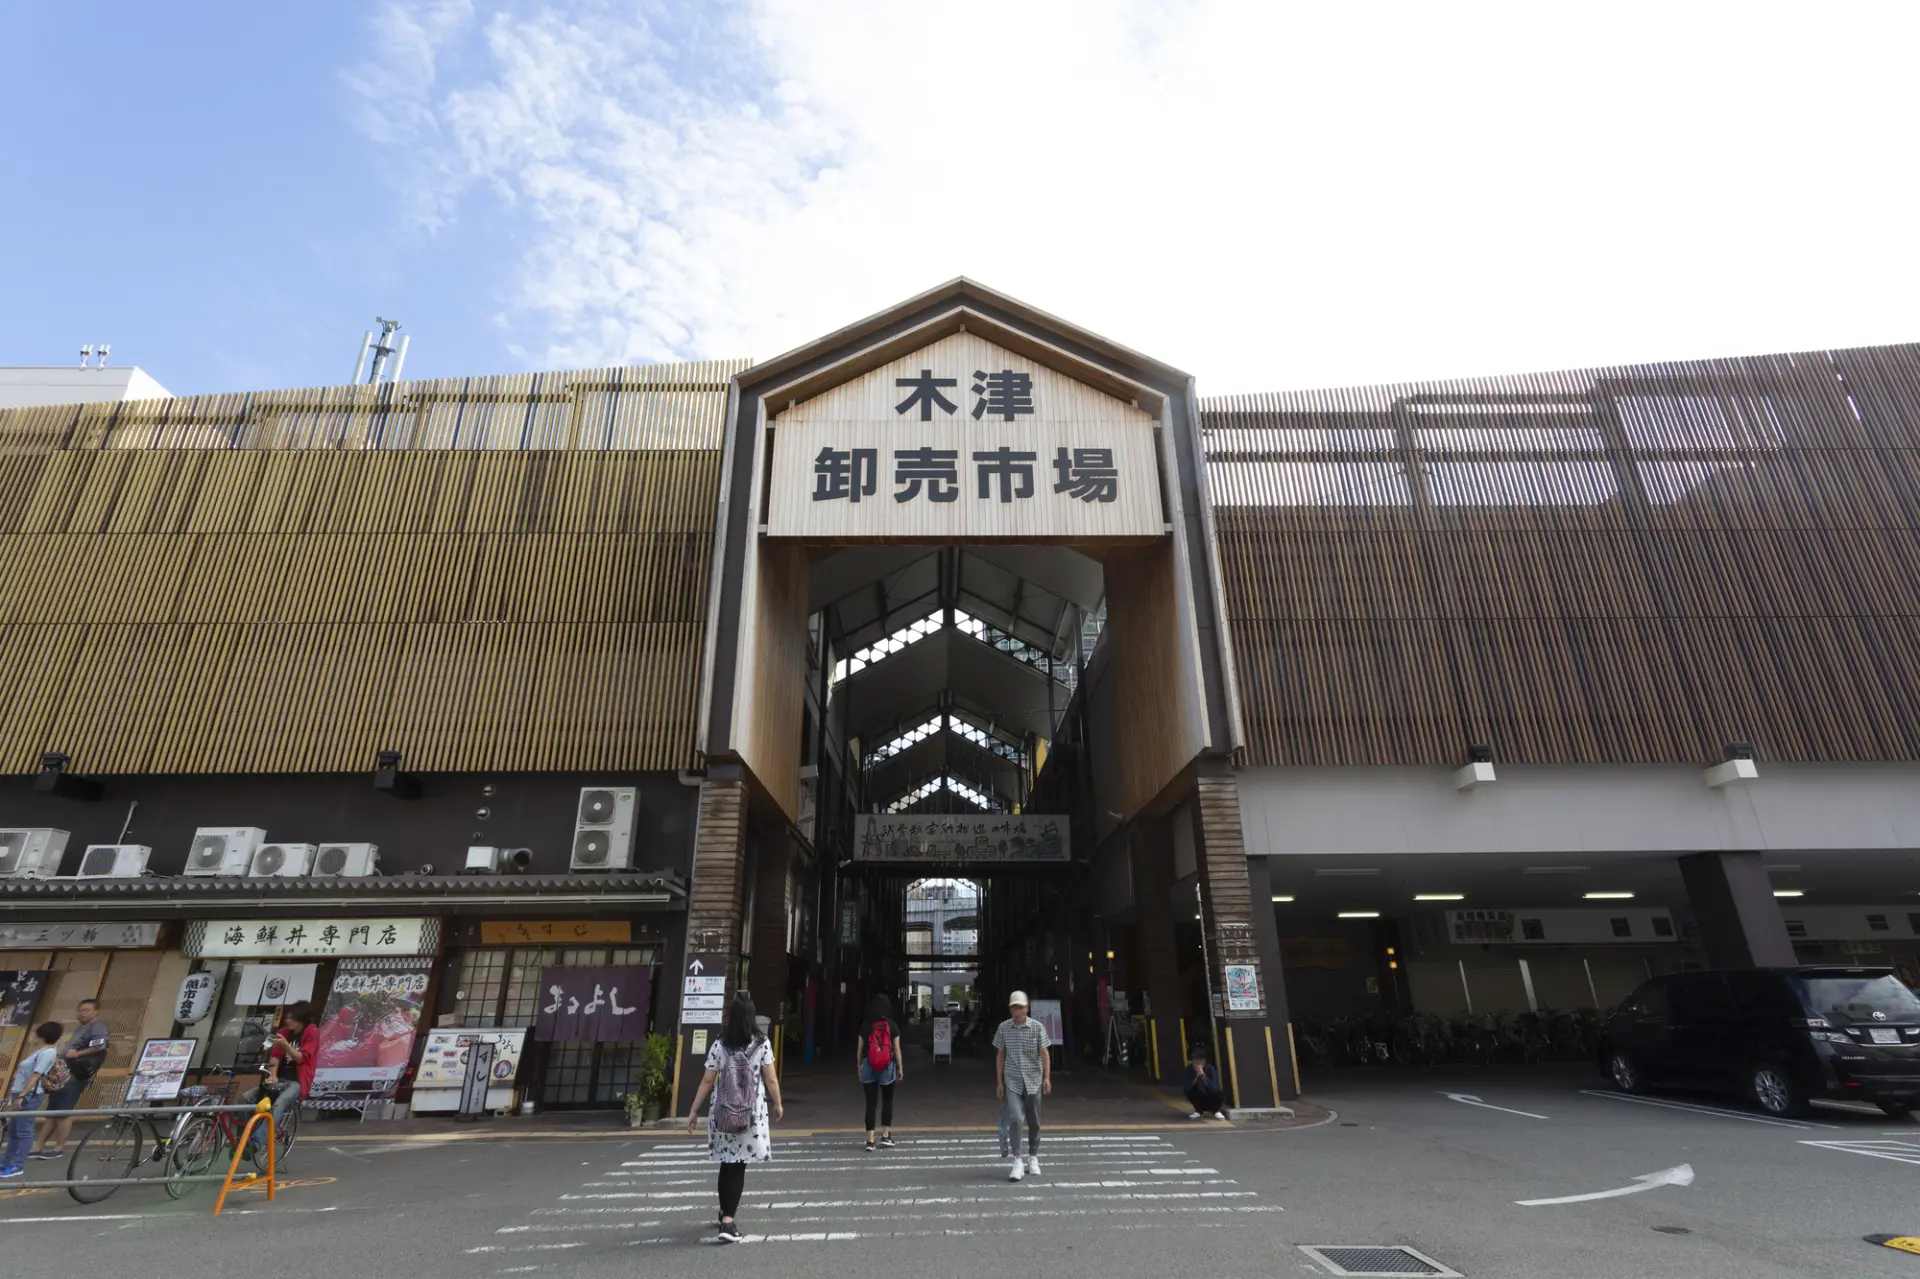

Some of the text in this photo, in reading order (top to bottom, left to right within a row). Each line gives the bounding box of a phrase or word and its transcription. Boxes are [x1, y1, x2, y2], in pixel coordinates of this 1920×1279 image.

[895, 369, 1034, 422] 木津
[812, 446, 1118, 504] 卸売市場
[223, 924, 399, 946] 海鮮丼専門店
[335, 975, 426, 992] 海鮮丼専門店
